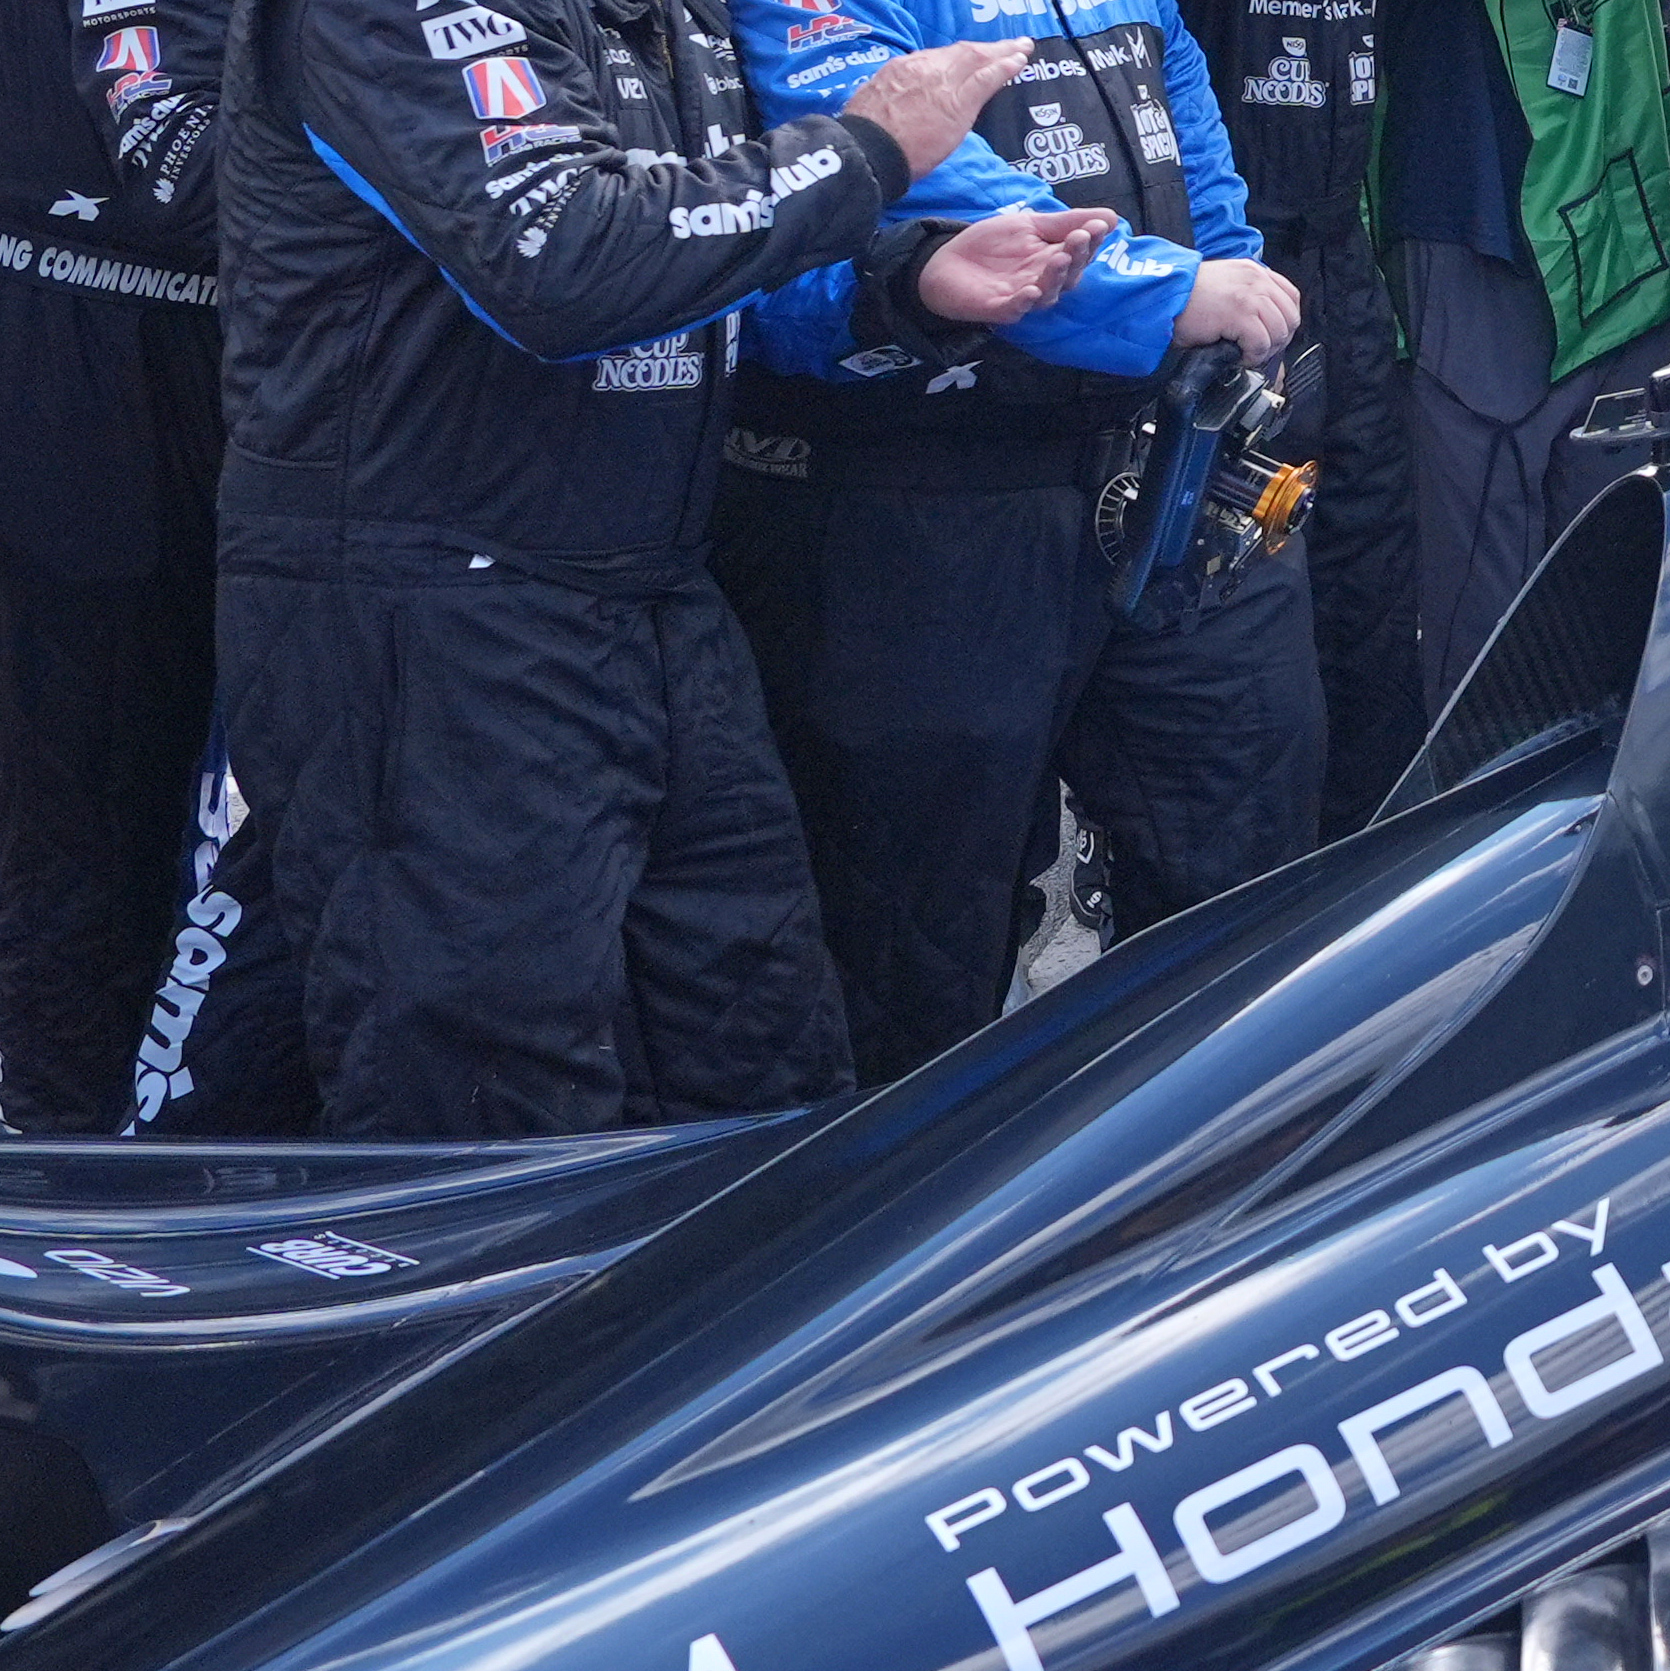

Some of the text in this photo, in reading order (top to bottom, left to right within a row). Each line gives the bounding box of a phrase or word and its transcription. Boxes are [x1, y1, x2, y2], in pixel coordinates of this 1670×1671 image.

[82, 5, 157, 30] MOTORSPORTS
[431, 10, 515, 53] TWG
[787, 44, 891, 90] sam's club
[159, 103, 215, 177] PHOENI
[1026, 125, 1083, 158] CUP
[672, 192, 775, 239] sam's
[592, 353, 704, 392] NOODLES
[924, 1197, 1612, 1553] Powered by
